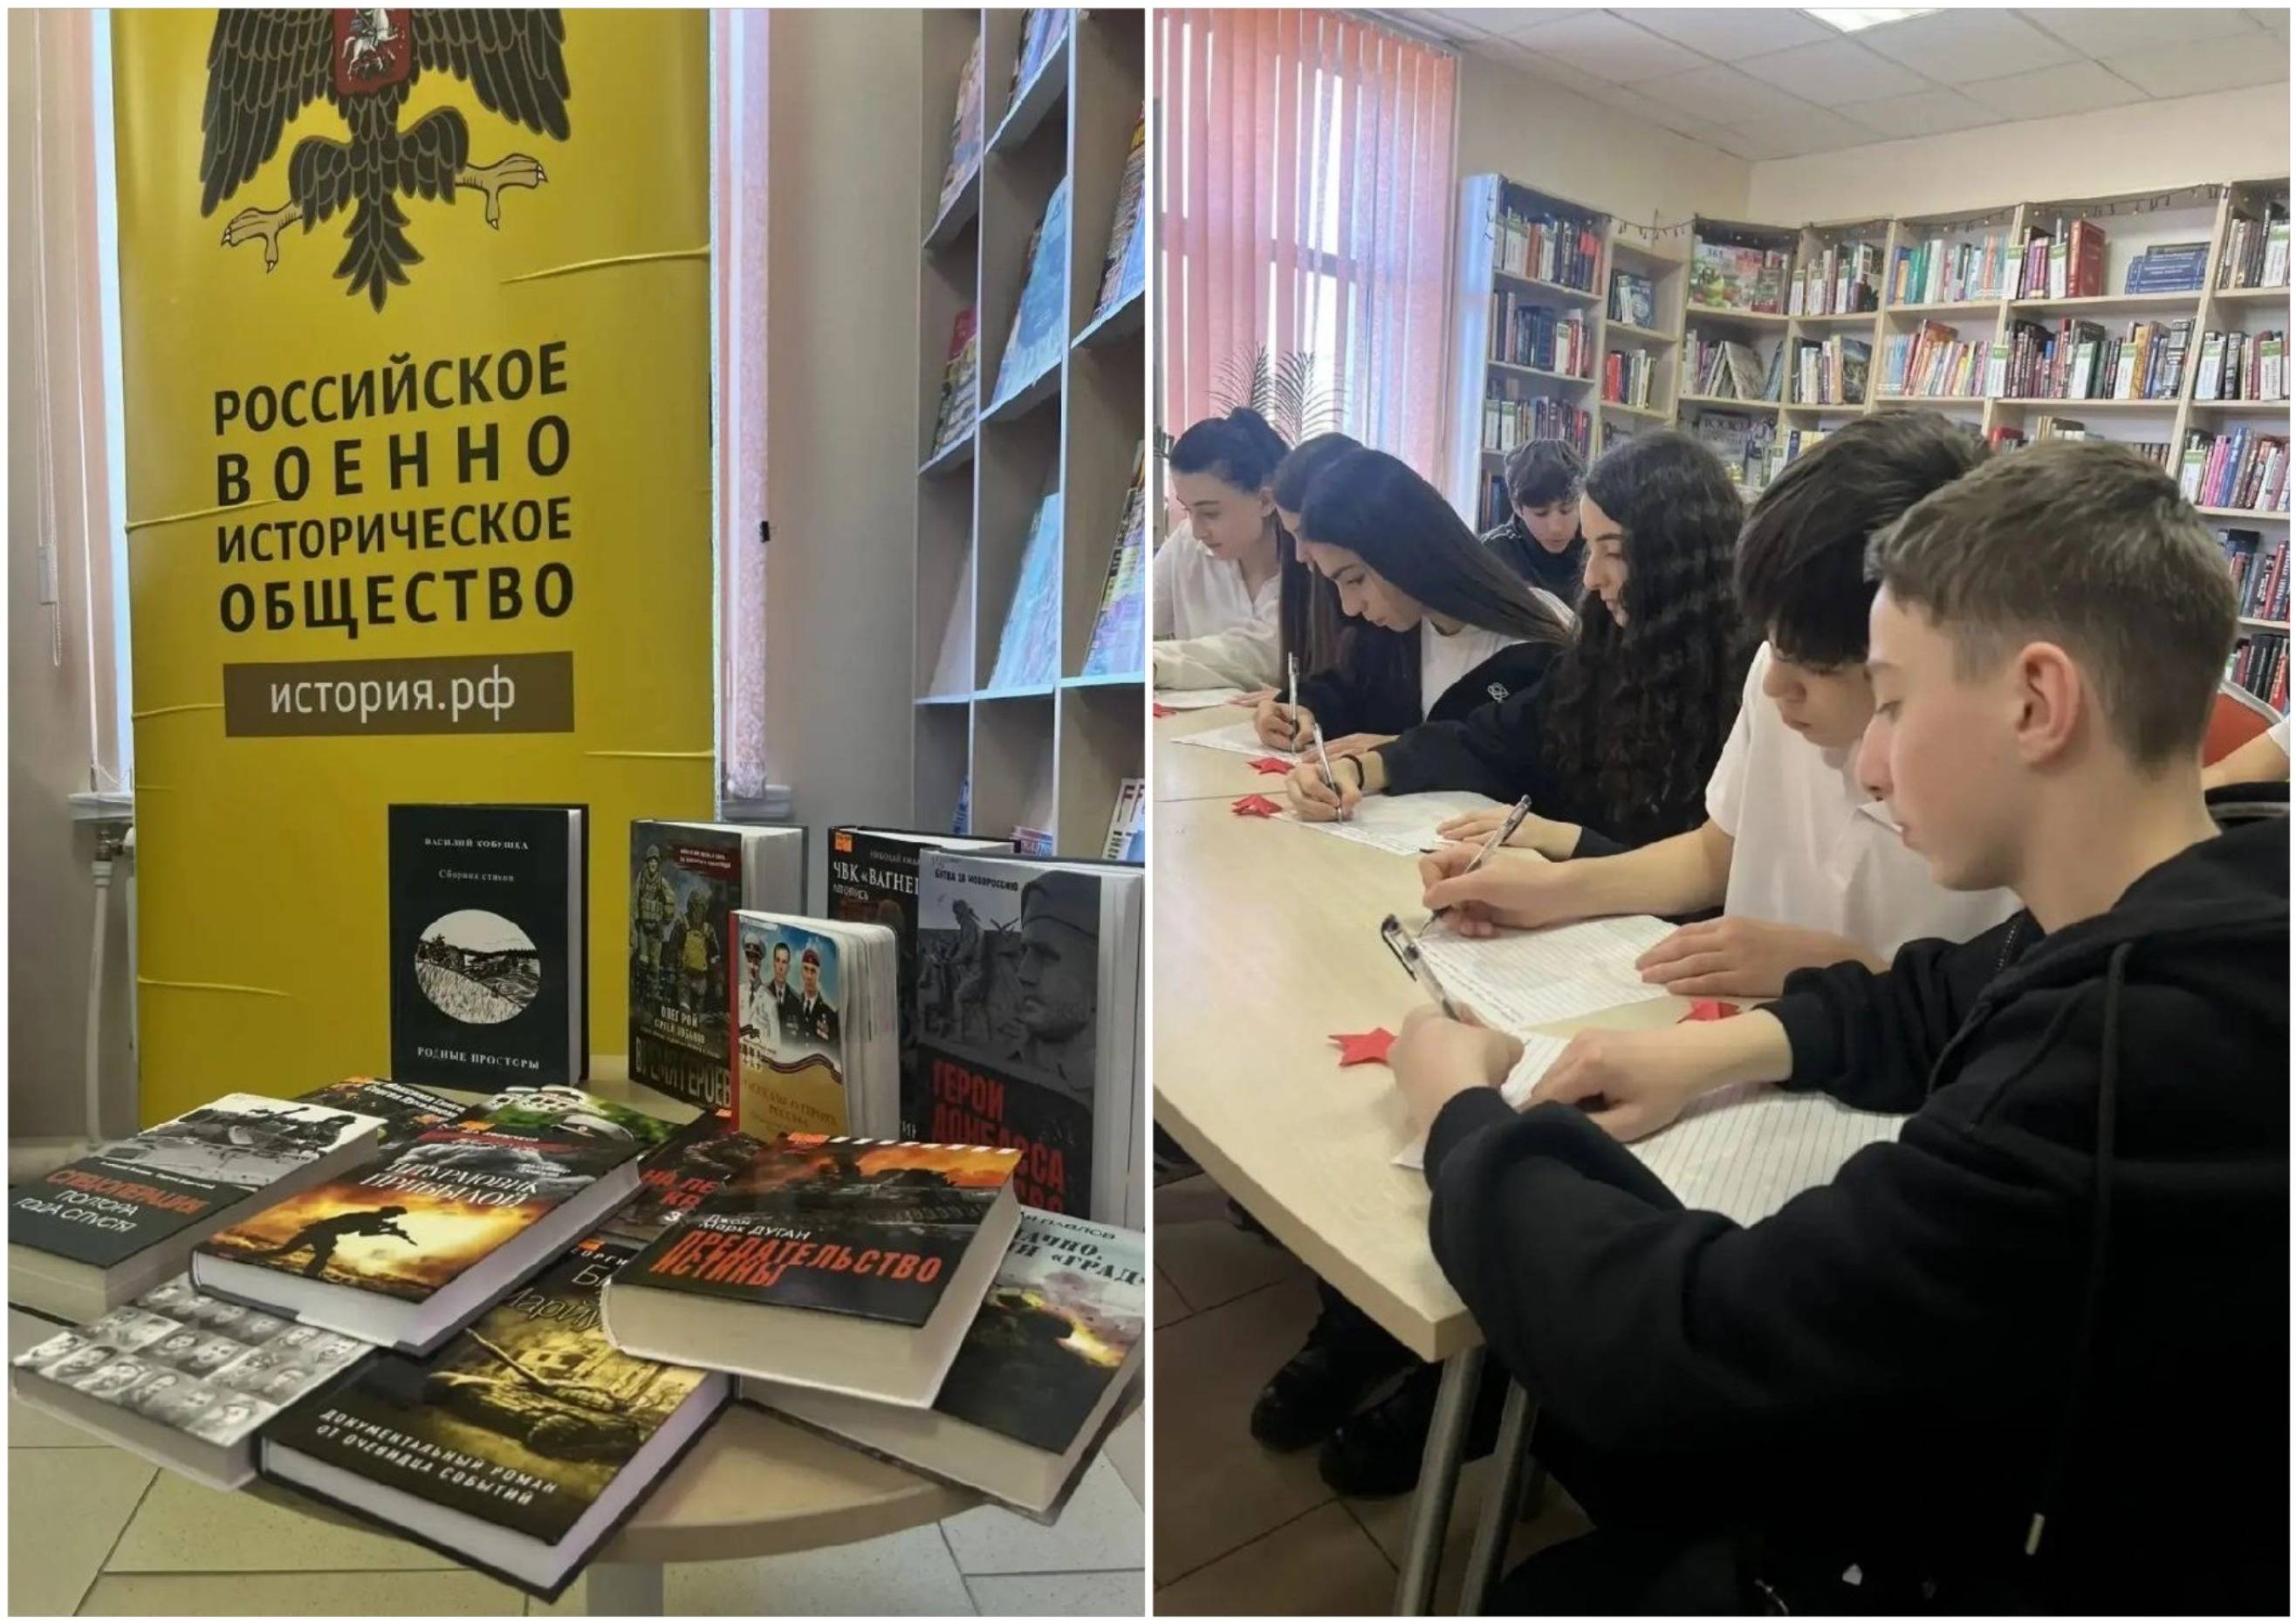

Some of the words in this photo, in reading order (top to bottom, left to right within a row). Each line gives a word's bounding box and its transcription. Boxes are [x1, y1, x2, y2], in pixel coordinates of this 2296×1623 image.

[215, 340, 567, 435] РОССИЙСКОЕ
[216, 414, 571, 507] ВОЕННО
[216, 496, 572, 564] ИСТОРИЧЕСКОЕ
[219, 561, 574, 640] ОБЩЕСТВО
[270, 663, 517, 724] история.рф
[833, 860, 860, 883] ЧВК
[417, 1046, 467, 1062] РОДНЫЕ
[471, 1053, 539, 1070] ПРОСТОРЫ
[932, 1058, 1004, 1123] ГЕРОИ
[14, 1196, 63, 1216] ГОДА
[60, 1208, 138, 1232] СПУСТЯ
[54, 1188, 140, 1216] ПОЛТОРА
[699, 1221, 745, 1234] Марк
[747, 1225, 812, 1242] ДУГАН
[649, 1248, 789, 1287] ИСТИНЫ
[674, 1229, 943, 1283] ПРЕДАТЕЛЬСТВО
[316, 1424, 340, 1438] ОТ
[343, 1434, 435, 1473] ОЧЕВИДЦА
[439, 1467, 534, 1505] СОБЫТИЙ
[319, 1408, 485, 1470] ДОКУМЕНТАЛЬНЫЙ
[490, 1466, 558, 1493] РОМАН
